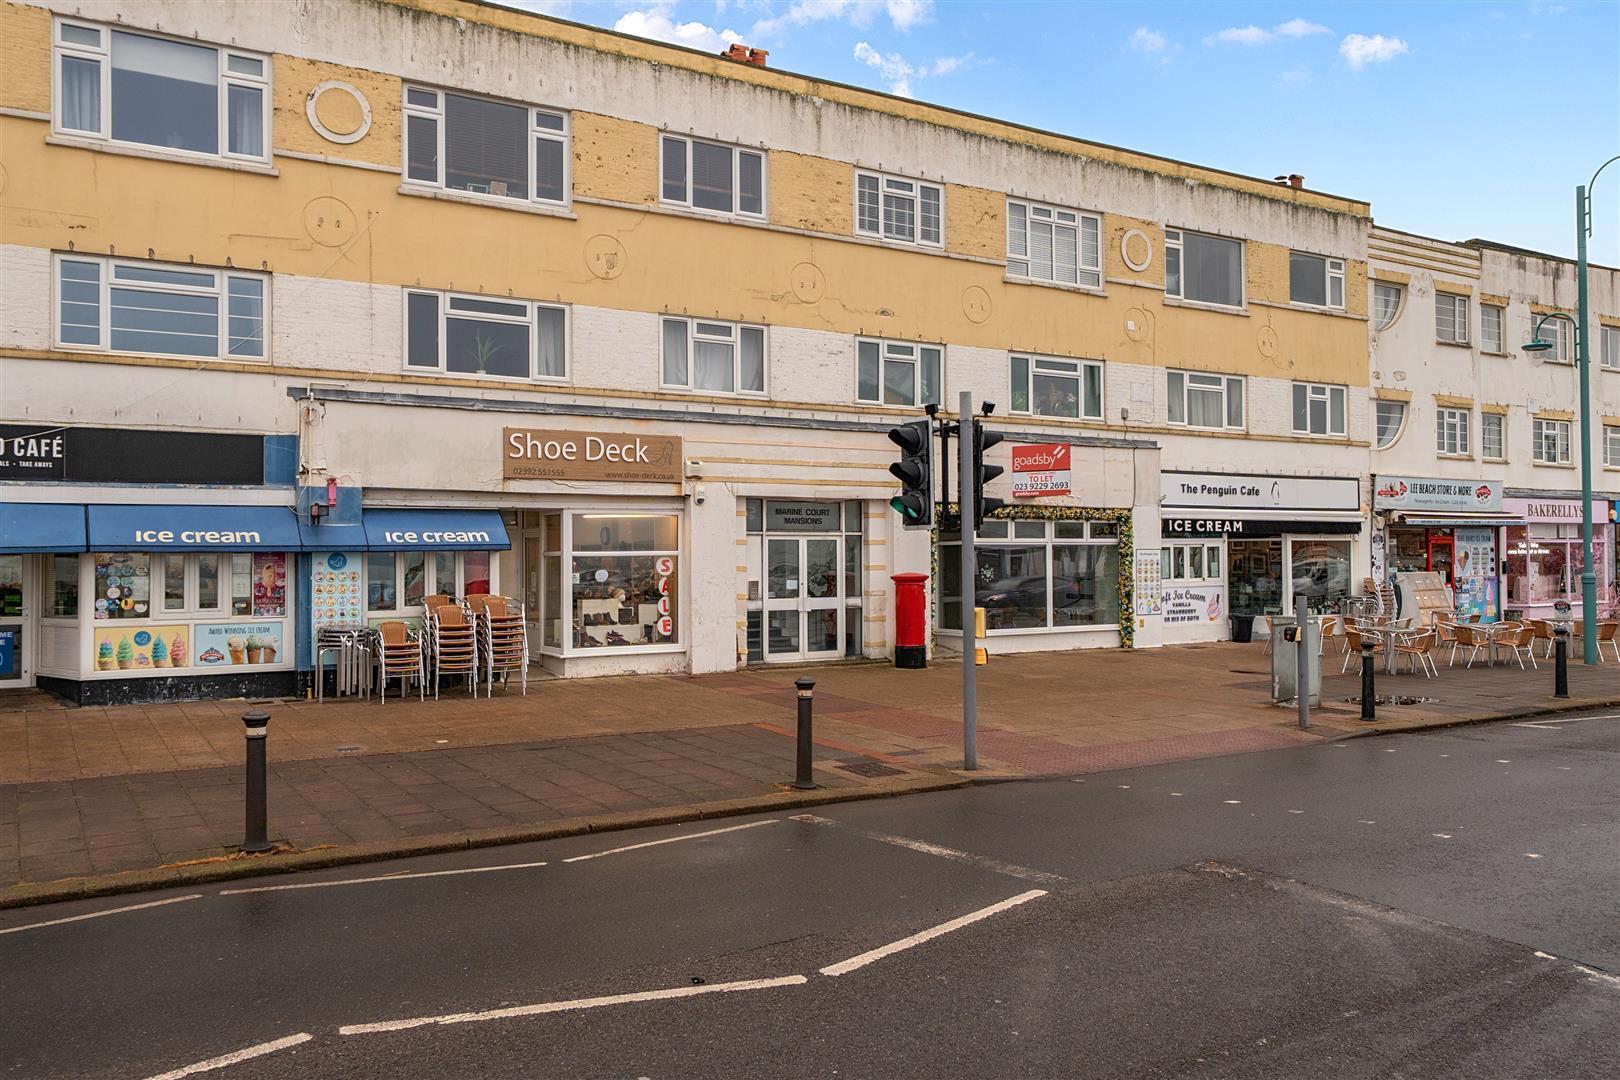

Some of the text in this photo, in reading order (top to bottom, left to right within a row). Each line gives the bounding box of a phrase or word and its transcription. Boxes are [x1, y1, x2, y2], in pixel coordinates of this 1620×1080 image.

[13, 436, 63, 458] CAFÉ
[509, 432, 649, 463] Shoe Deck
[1013, 452, 1056, 470] goadsby
[513, 466, 536, 476] 02392
[1014, 481, 1069, 491] 023 9229 2693
[1181, 483, 1260, 497] The Penguin Cafe
[1410, 483, 1419, 494] LEE
[1419, 484, 1436, 495] BEACH
[1437, 485, 1452, 495] STORE
[1453, 486, 1457, 495] &
[1458, 486, 1472, 496] MORE
[775, 508, 831, 516] MARINE COURT
[784, 517, 823, 525] MANSIONS
[1169, 520, 1243, 532] ICE CREAM
[181, 530, 260, 543] cream
[422, 531, 490, 543] cream
[660, 559, 672, 633] SALE
[1161, 589, 1206, 605] oft Ice Cream
[224, 627, 247, 635] WINNING
[256, 626, 270, 634] CREAM
